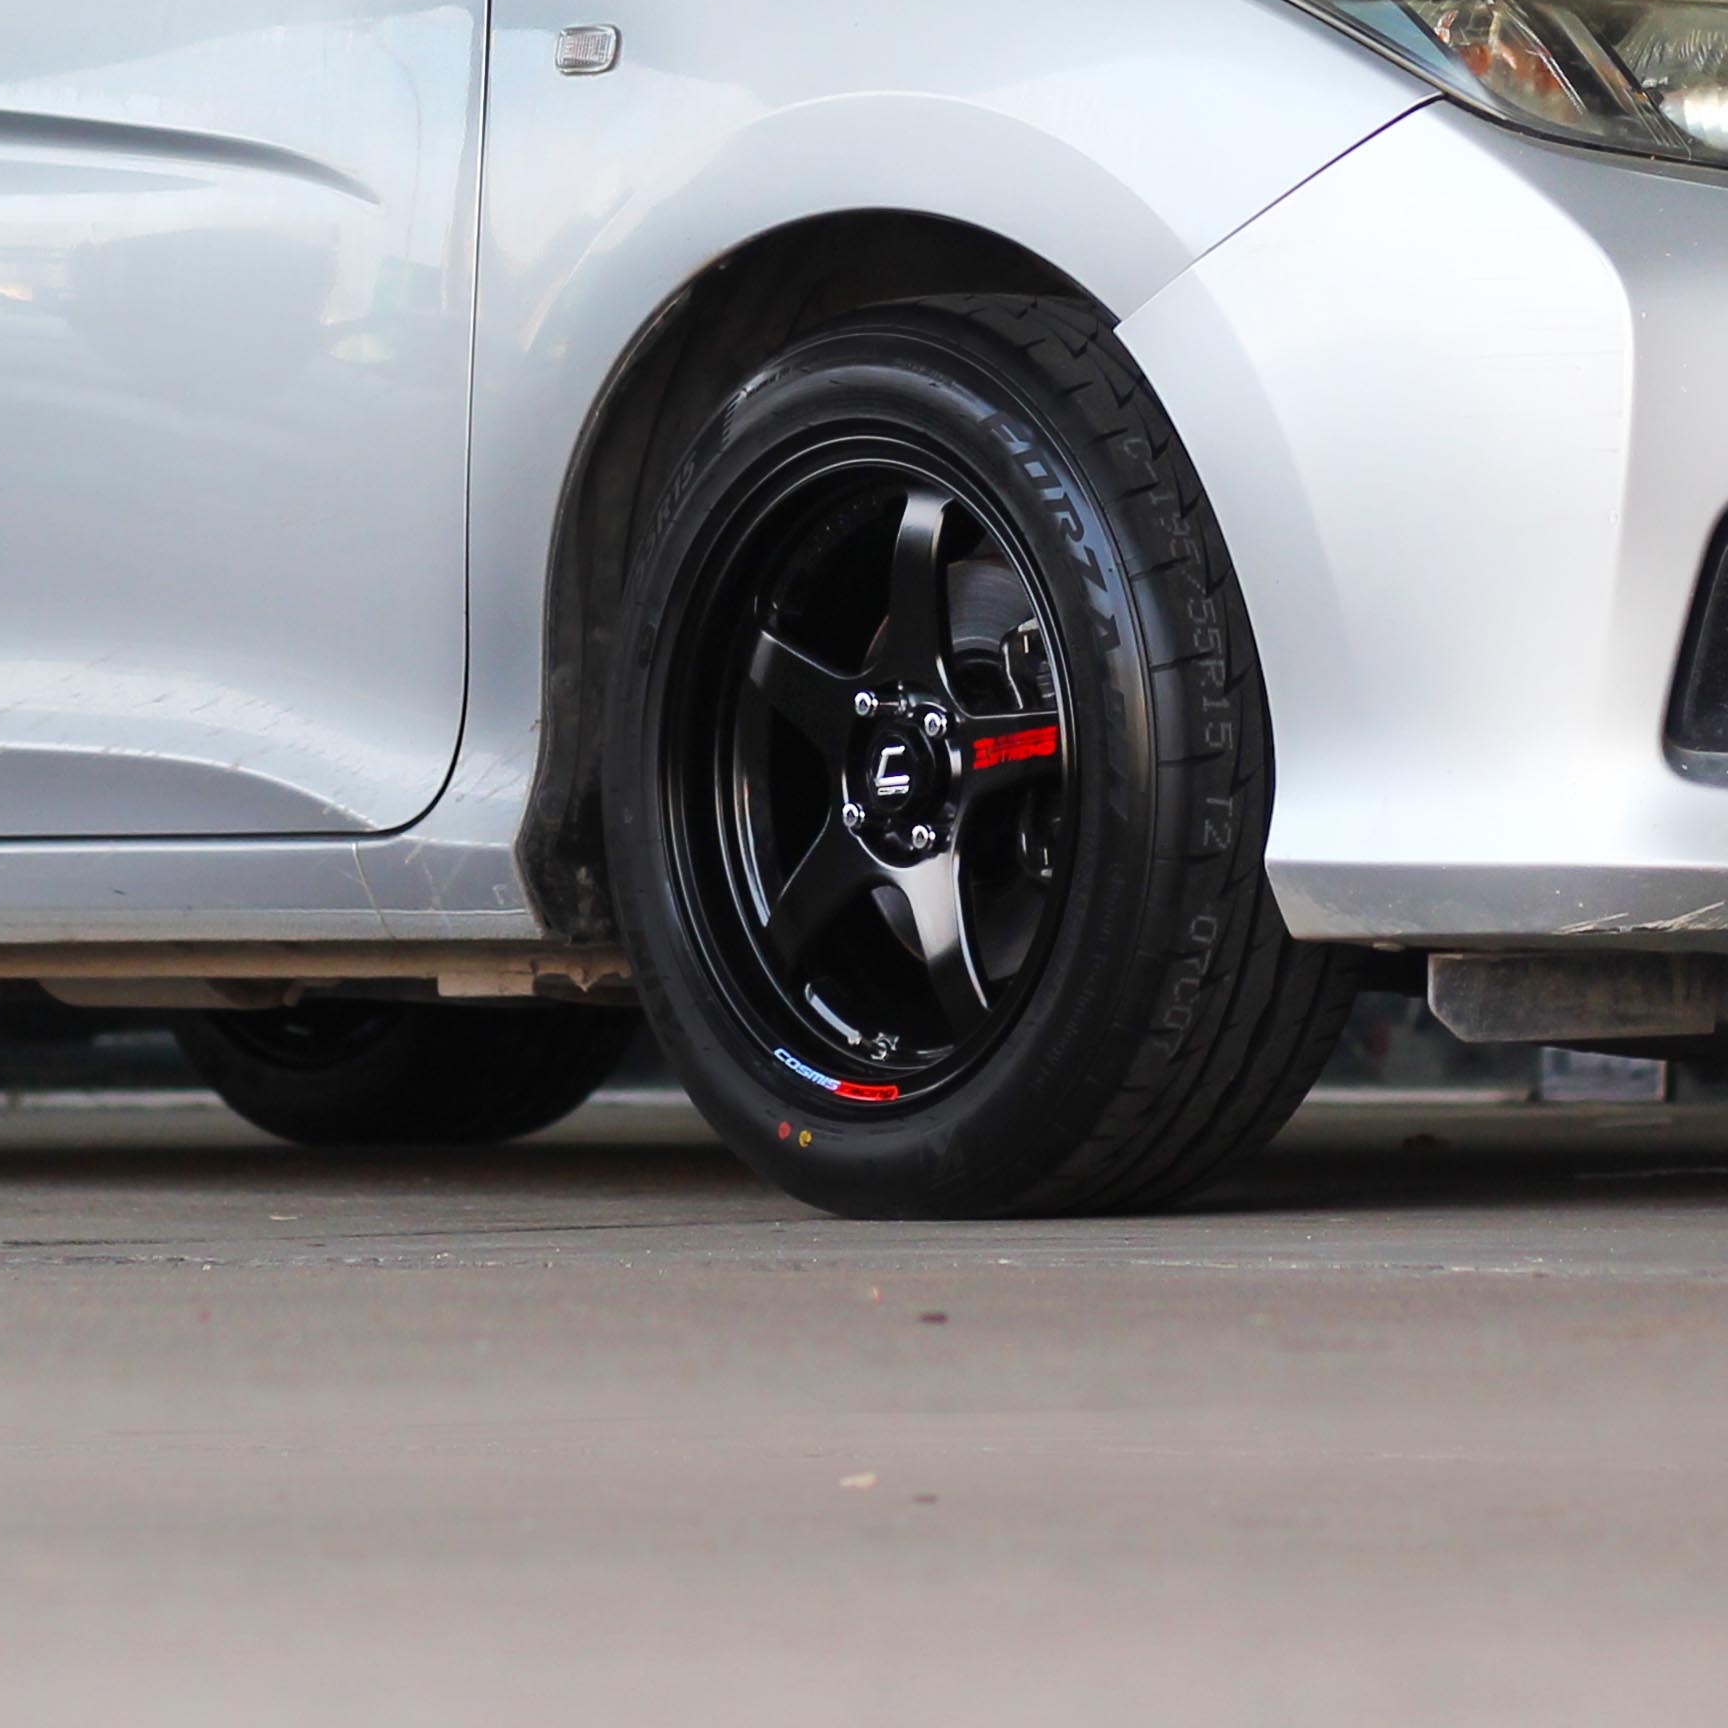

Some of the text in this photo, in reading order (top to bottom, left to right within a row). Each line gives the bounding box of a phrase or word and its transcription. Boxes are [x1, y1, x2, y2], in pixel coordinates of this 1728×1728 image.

[981, 409, 1122, 652] FORZA
[1203, 793, 1234, 851] T2
[774, 1047, 842, 1092] COSMIS
